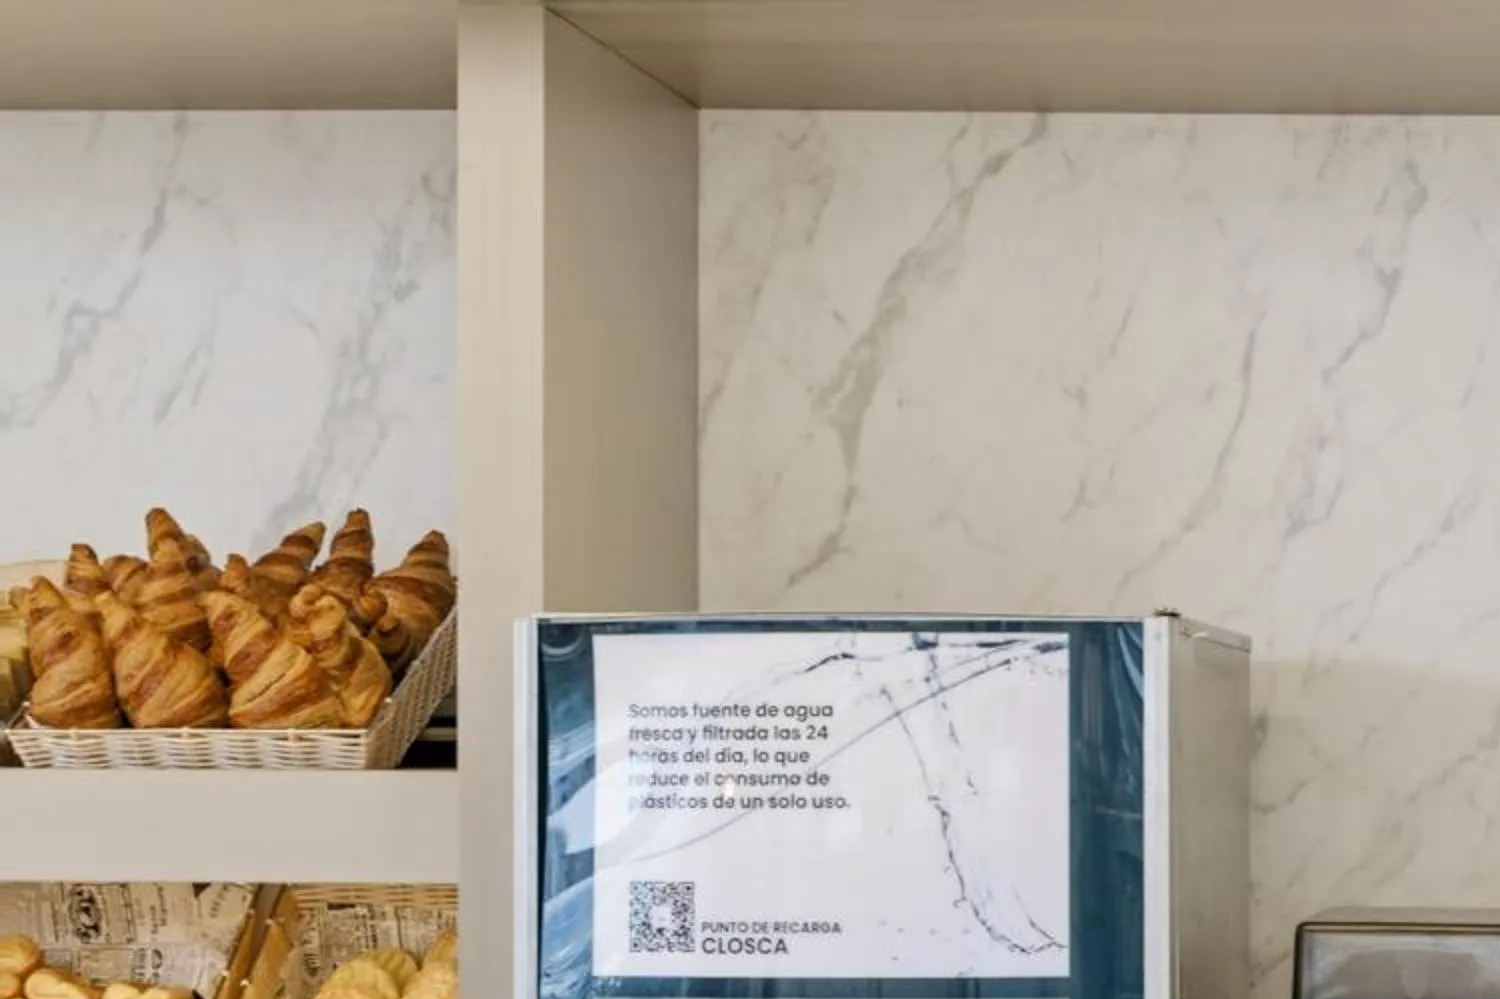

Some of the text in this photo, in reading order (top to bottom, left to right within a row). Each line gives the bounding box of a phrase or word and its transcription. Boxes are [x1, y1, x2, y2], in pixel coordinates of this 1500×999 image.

[628, 703, 834, 722] Somos fuente de agua
[628, 725, 829, 744] fresca y filtrada las 24
[629, 748, 678, 764] horas
[683, 748, 710, 763] del
[753, 748, 769, 763] lo
[774, 750, 811, 767] que
[694, 771, 709, 786] el
[714, 773, 802, 787] consumo
[805, 771, 831, 786] de
[713, 794, 735, 809] de
[740, 796, 764, 810] un
[768, 794, 807, 809] solo
[812, 796, 851, 810] uso.
[701, 921, 842, 934] PUNTO DE RECARGA
[701, 937, 790, 955] CLOSCA
